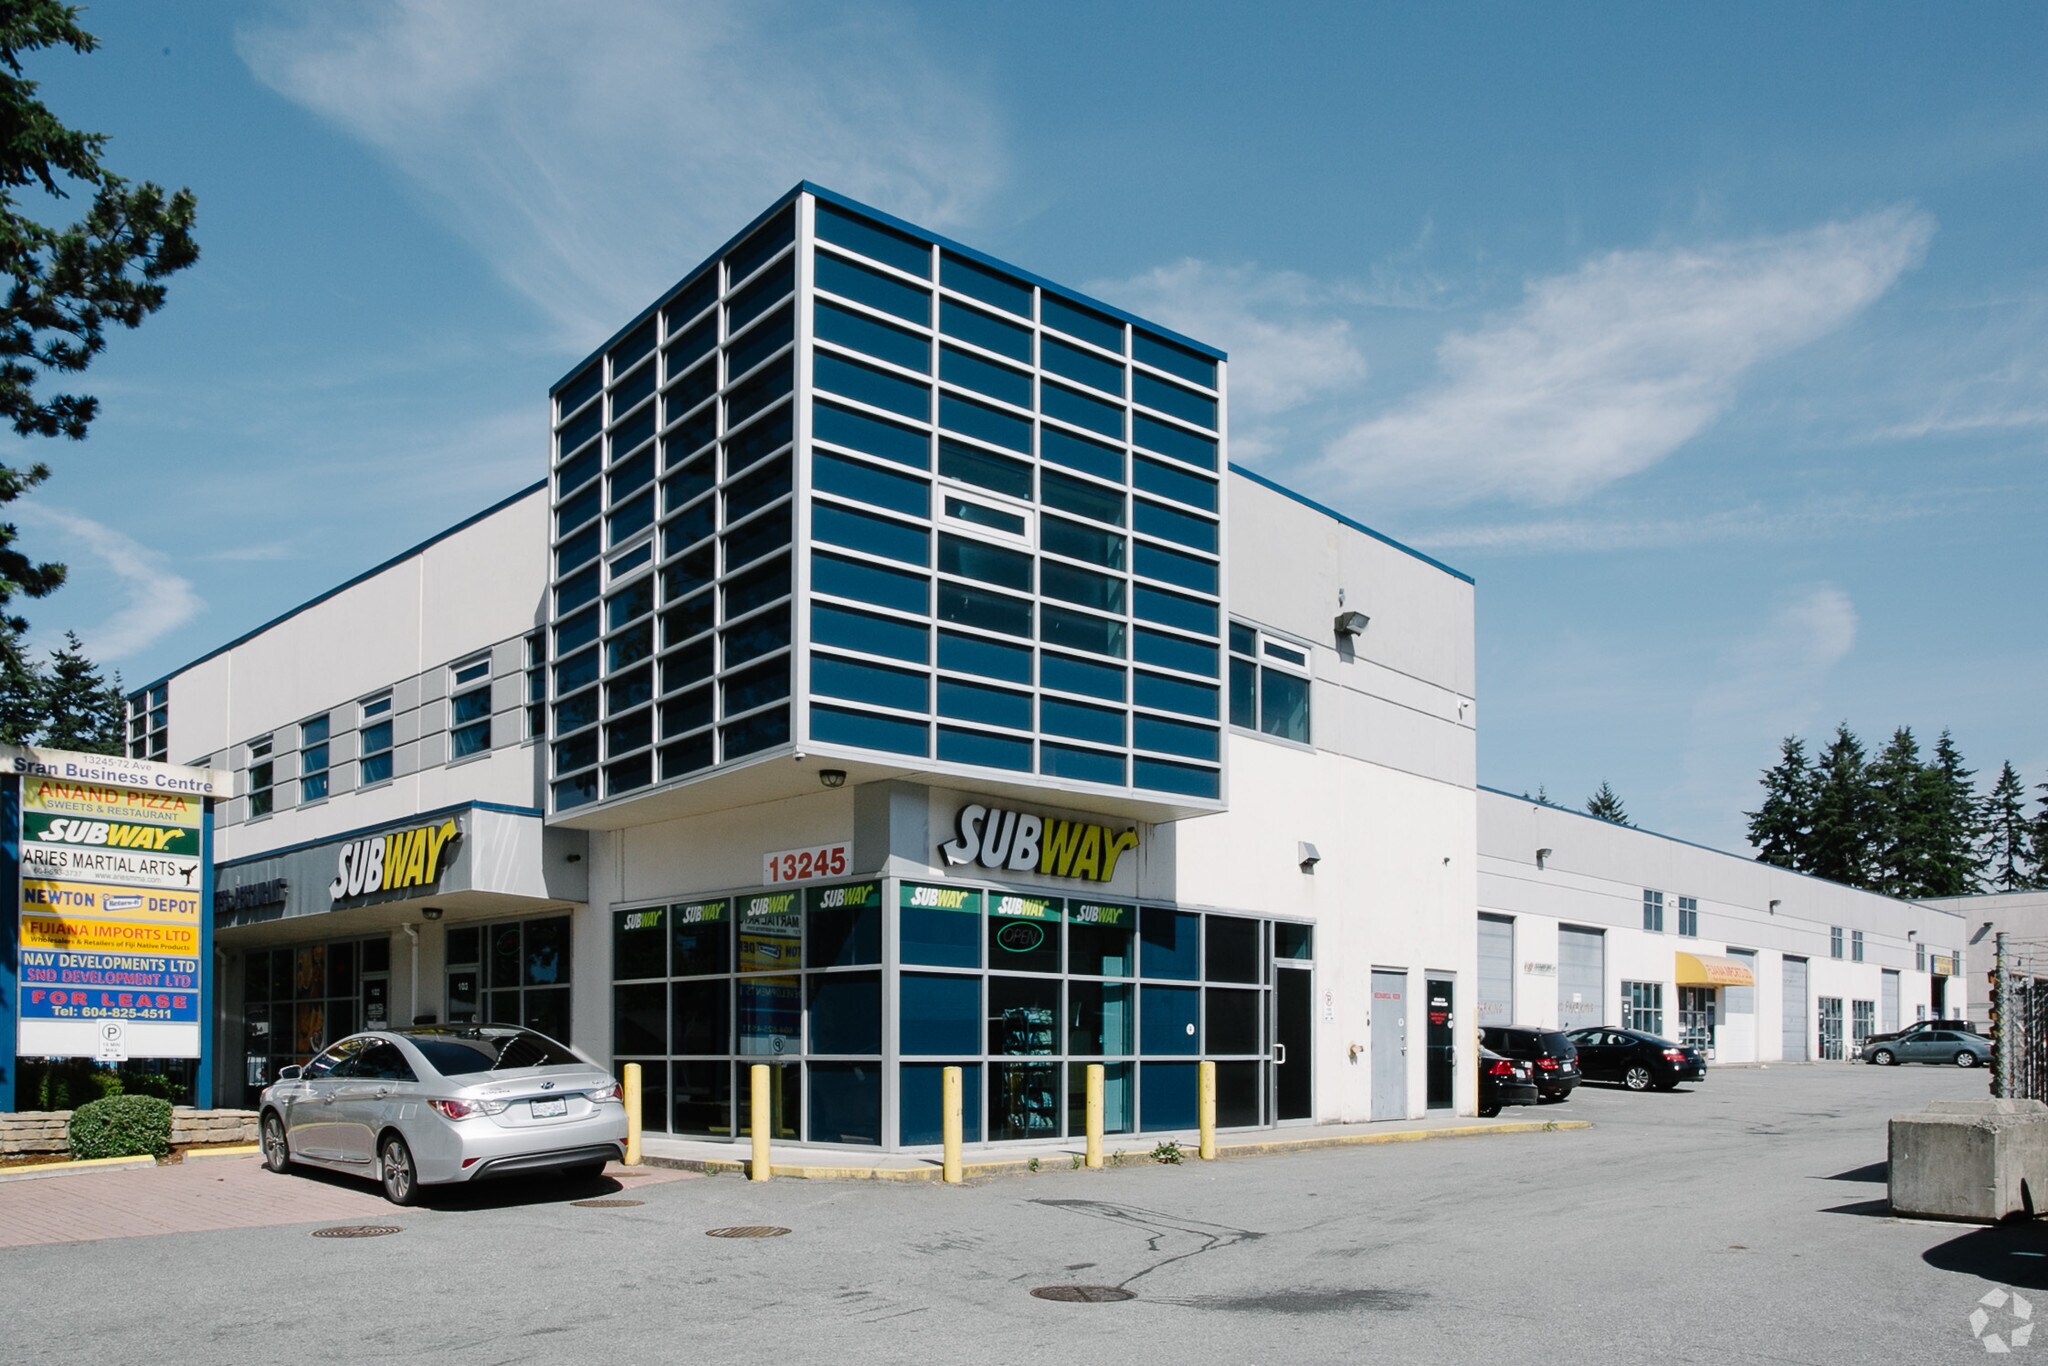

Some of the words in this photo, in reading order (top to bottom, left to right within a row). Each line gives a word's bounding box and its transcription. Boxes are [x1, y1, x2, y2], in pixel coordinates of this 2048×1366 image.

[15, 757, 58, 775] Sran
[66, 763, 149, 785] Business
[155, 774, 213, 793] Centre
[132, 762, 152, 771] Ave
[38, 781, 119, 804] ANAND
[127, 792, 188, 812] PIZZA
[46, 800, 94, 812] SWEETS
[107, 807, 178, 821] RESTAURANT
[38, 818, 185, 850] SUBWAY
[938, 804, 1140, 882] SUBWAY
[22, 849, 68, 867] ARIES
[72, 853, 135, 872] MARTIAL
[139, 860, 176, 876] ARTS
[329, 817, 463, 901] SUBWAY
[769, 847, 846, 882] 13245
[24, 888, 95, 907] NEWTON
[149, 897, 197, 914] DEPOT
[747, 894, 795, 916] SUBWAY
[820, 885, 874, 908] SUBWAY
[910, 887, 968, 909] SUBWAY
[998, 896, 1050, 917] SUBWAY
[624, 910, 663, 930] SUBWAY
[682, 902, 725, 924] SUBWAY
[1076, 904, 1123, 925] SUBWAY
[30, 921, 88, 936] FIJIANA
[94, 926, 161, 940] IMPORTS
[165, 931, 191, 942] LTD
[30, 936, 75, 944] Wholesalers
[1003, 928, 1038, 945] OPEN
[24, 953, 54, 966] NAV
[59, 954, 165, 972] DEVELOPMENTS
[171, 960, 196, 973] LTD
[27, 968, 57, 982] SND
[62, 970, 161, 986] DEVELOPMENT
[166, 974, 191, 988] LTD
[32, 990, 88, 1006] FOR
[101, 993, 187, 1009] LEASE
[52, 1006, 78, 1017] Tel:
[82, 1007, 171, 1019] 604-825-4511
